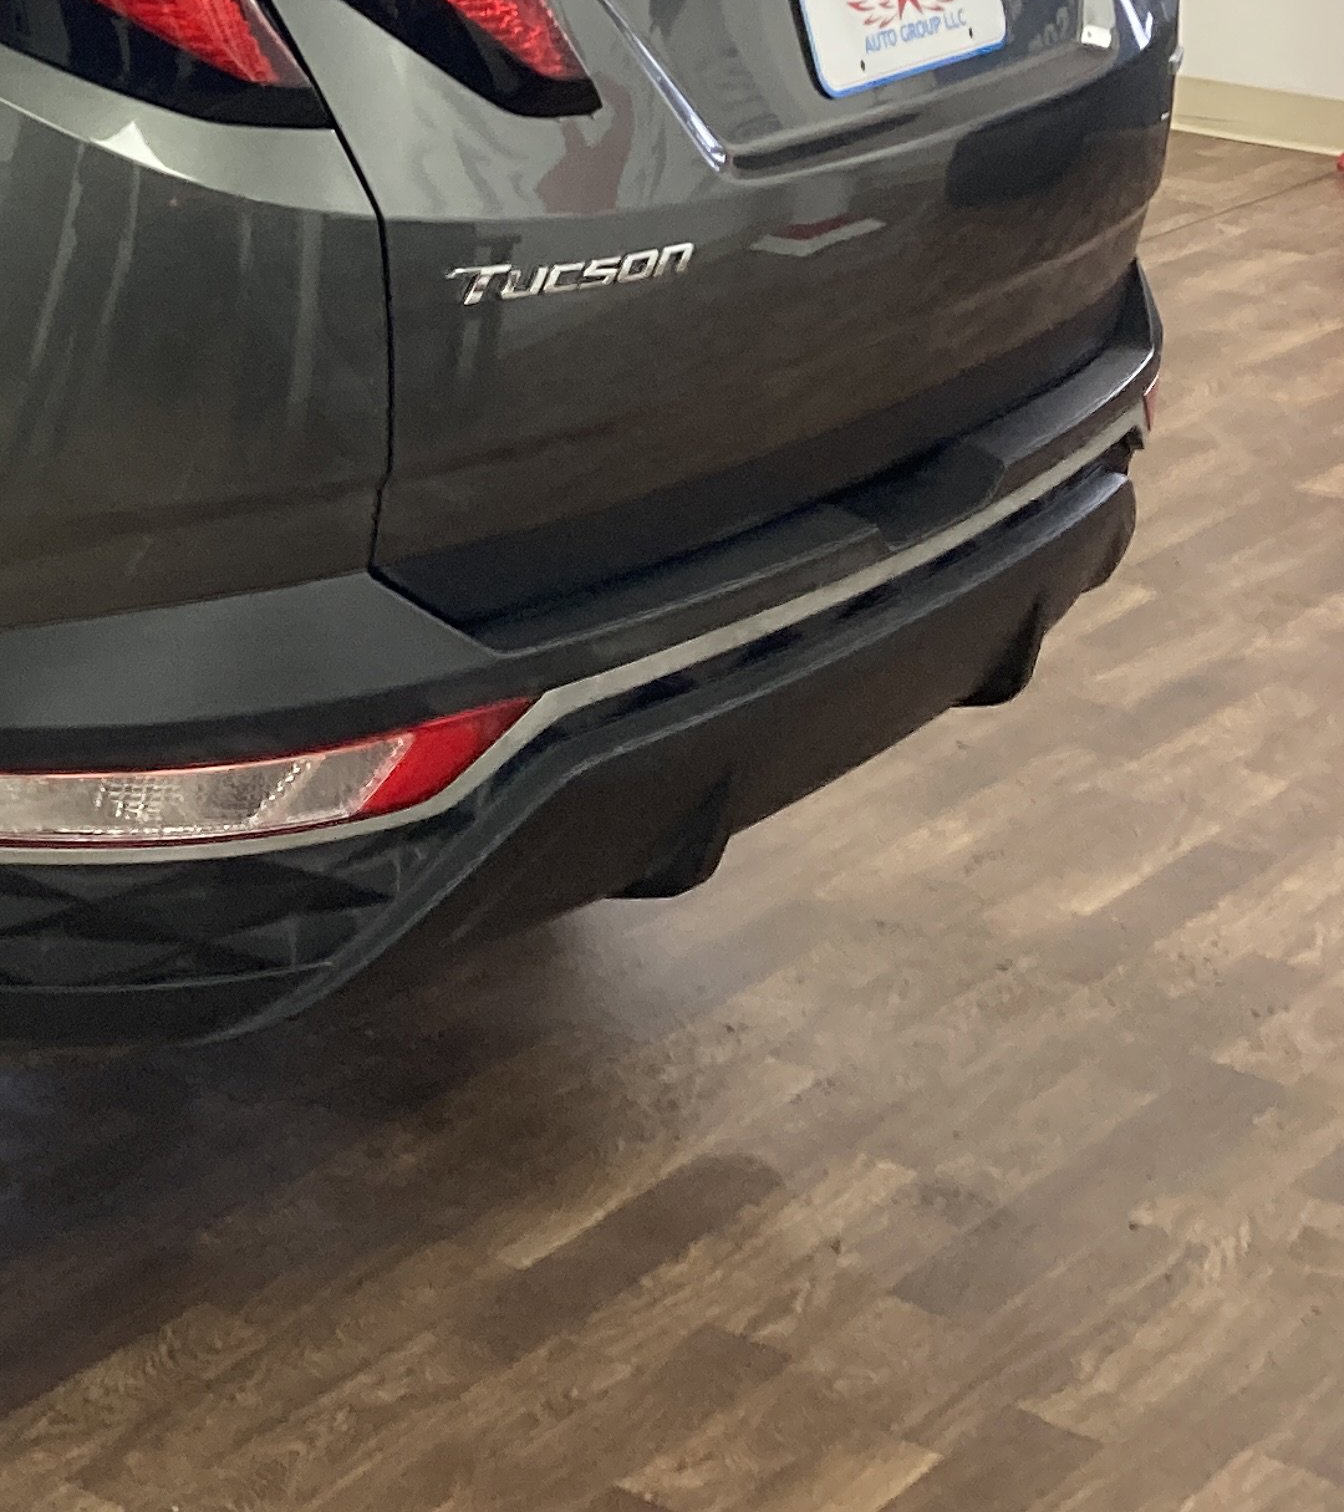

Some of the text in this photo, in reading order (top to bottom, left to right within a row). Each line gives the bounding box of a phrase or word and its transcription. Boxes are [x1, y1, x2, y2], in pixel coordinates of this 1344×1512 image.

[865, 7, 967, 55] AUTO GROUP LLC
